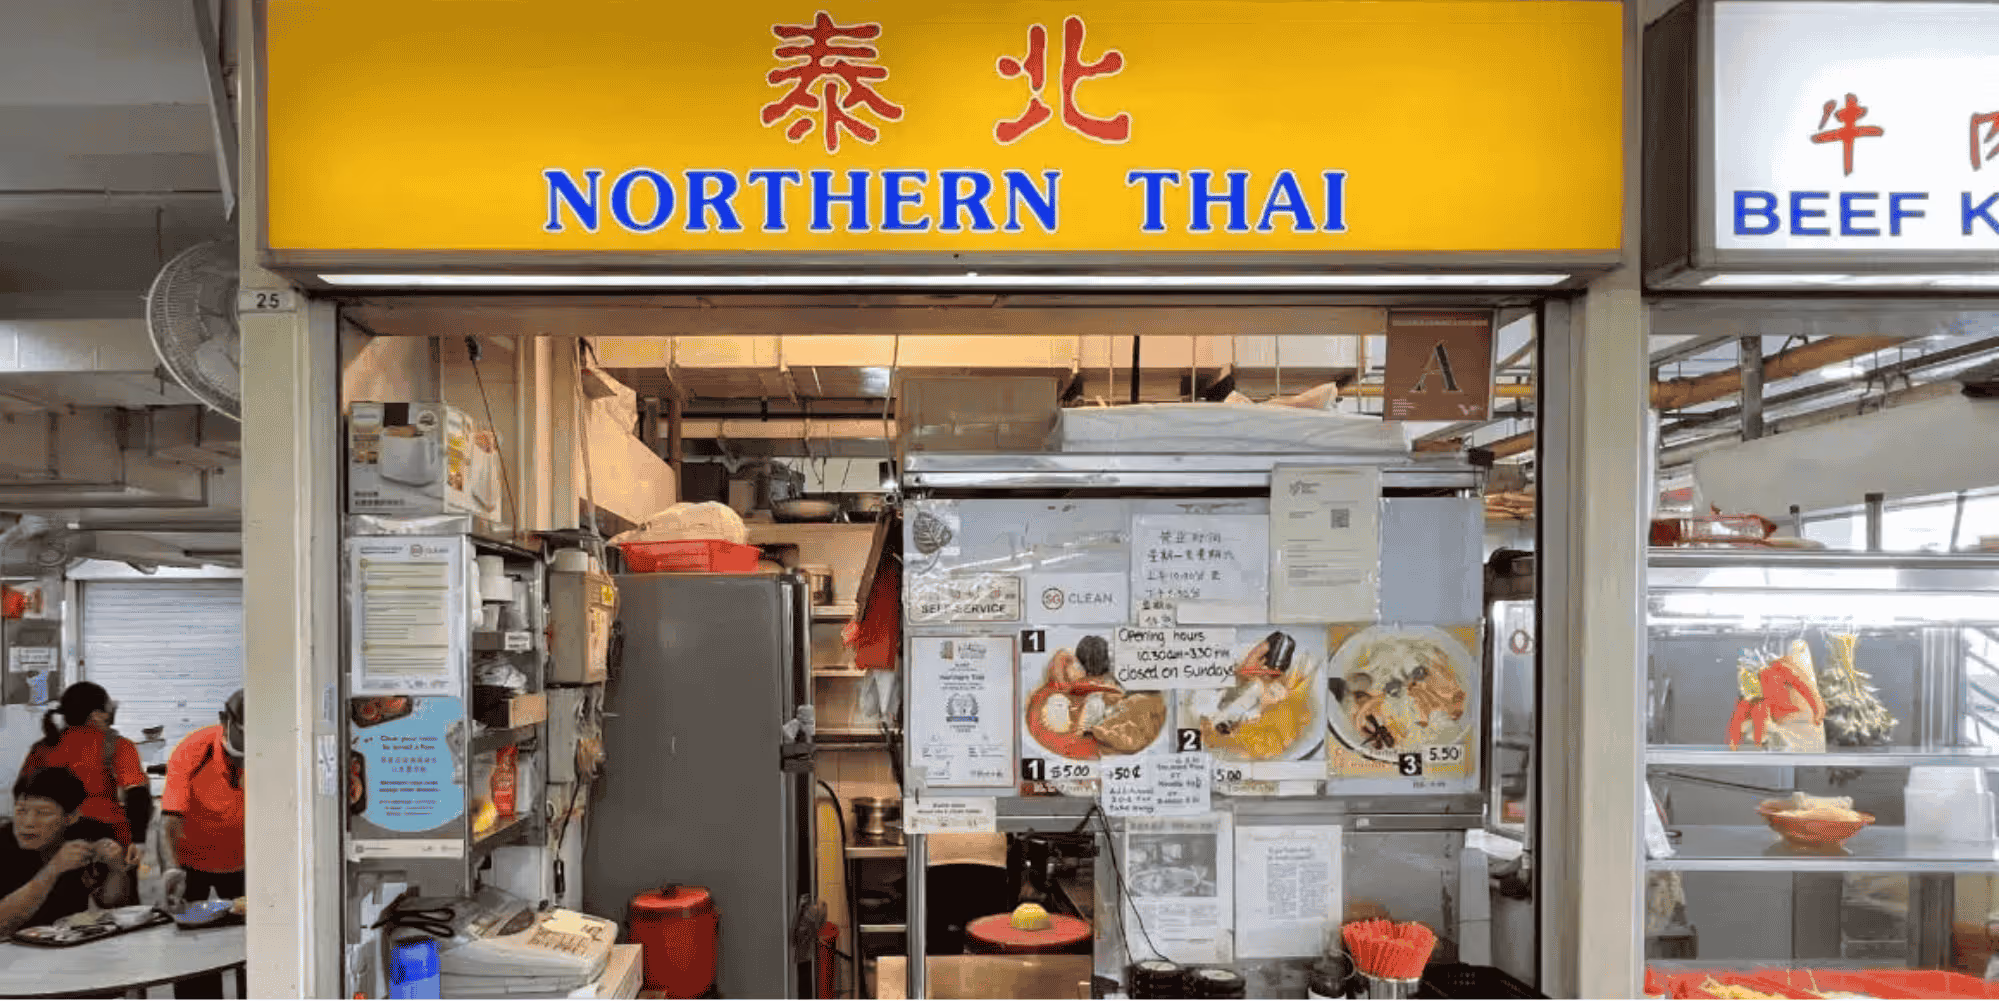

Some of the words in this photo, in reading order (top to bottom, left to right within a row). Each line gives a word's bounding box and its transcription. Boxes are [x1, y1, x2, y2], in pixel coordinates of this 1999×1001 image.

[543, 168, 1063, 234] NORTHERN
[1127, 168, 1349, 234] THAI
[1733, 190, 1929, 237] BEEF
[257, 293, 280, 309] 25
[1409, 339, 1464, 393] A
[1068, 592, 1113, 605] CLEAN
[1028, 631, 1039, 651] 1
[1173, 630, 1206, 642] hours
[1162, 666, 1178, 679] on
[1183, 730, 1197, 751] 2
[1429, 747, 1459, 761] 5.50
[1028, 760, 1039, 779] 1
[1404, 755, 1417, 774] 3
